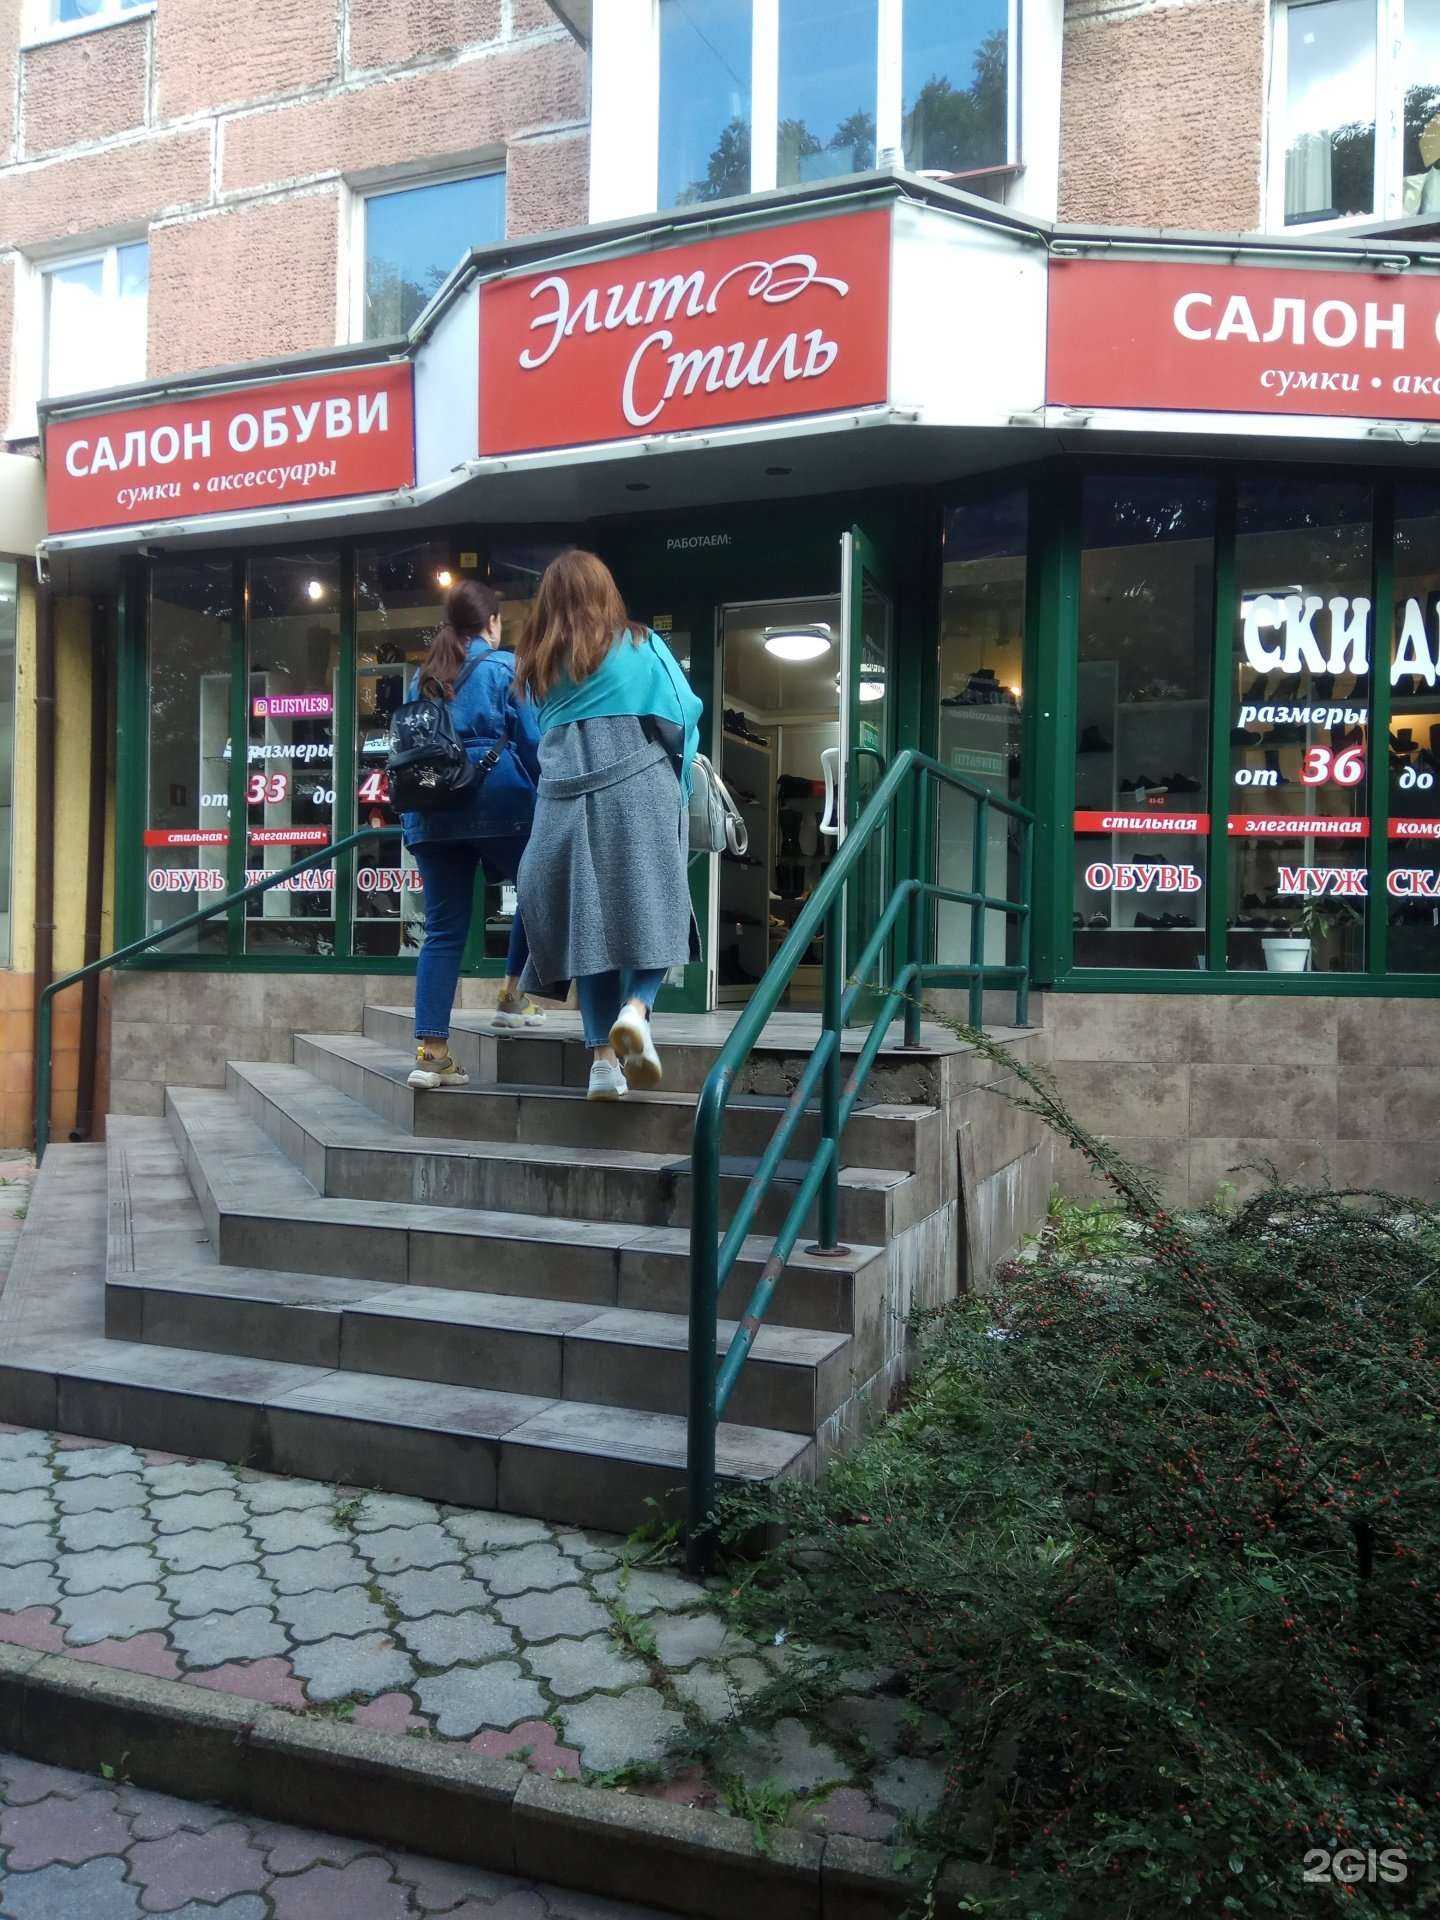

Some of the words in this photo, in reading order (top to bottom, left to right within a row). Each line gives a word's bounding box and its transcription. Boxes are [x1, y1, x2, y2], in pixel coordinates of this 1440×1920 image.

[519, 254, 849, 369] Элит
[1173, 292, 1406, 350] САЛОН
[622, 329, 839, 427] Стиль
[1260, 368, 1360, 396] сумки
[65, 420, 211, 477] САЛОН
[228, 392, 389, 453] ОБУВИ
[117, 484, 182, 505] сумки
[207, 459, 337, 493] аксессуары
[1238, 703, 1368, 729] размеры
[247, 744, 335, 763] размеры
[1235, 768, 1278, 787] от
[1300, 745, 1364, 787] 36
[1399, 766, 1434, 789] до
[200, 793, 229, 807] от
[246, 773, 288, 804] 33
[312, 785, 337, 804] до
[358, 770, 392, 804] 4
[168, 832, 223, 842] стильная
[251, 829, 322, 841] элегантная
[1101, 815, 1198, 831] стильная
[1245, 818, 1362, 834] элегантная
[1396, 821, 1440, 838] ком
[149, 867, 226, 892] ОБУВЬ
[1085, 863, 1202, 892] ОБУВЬ
